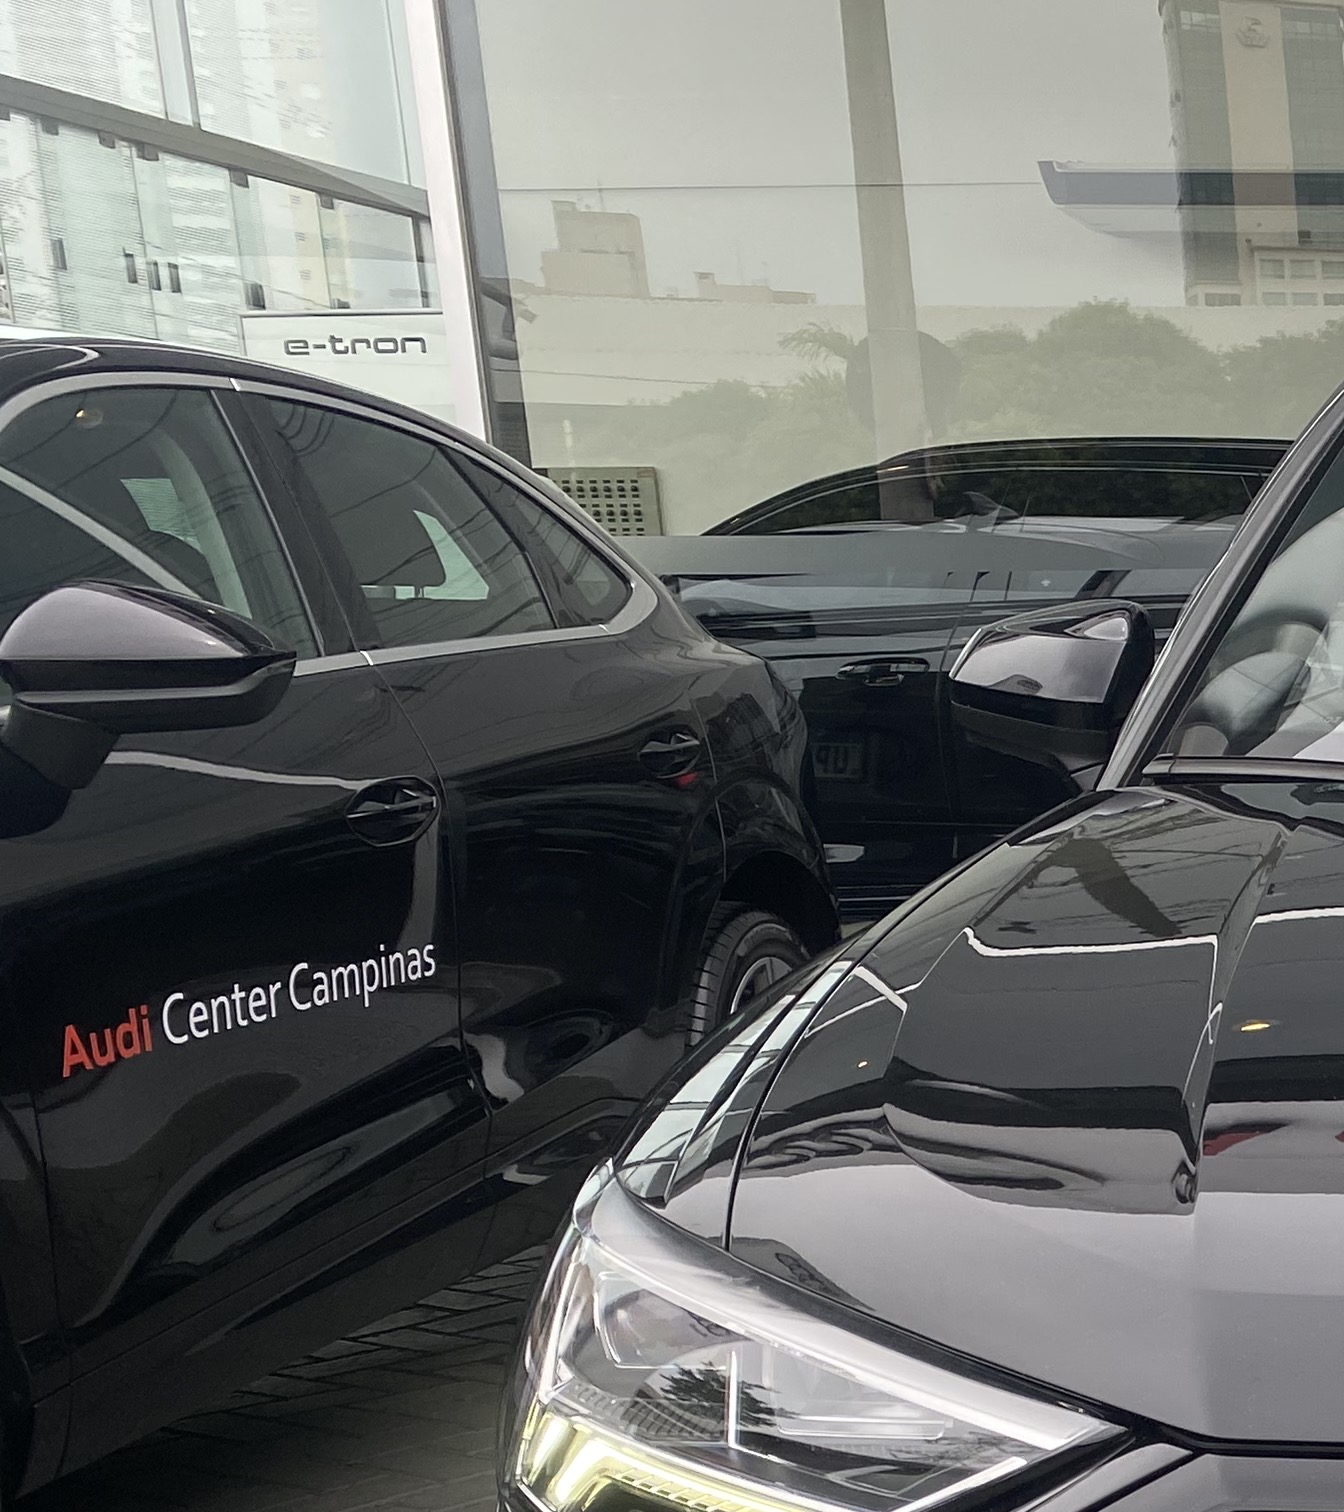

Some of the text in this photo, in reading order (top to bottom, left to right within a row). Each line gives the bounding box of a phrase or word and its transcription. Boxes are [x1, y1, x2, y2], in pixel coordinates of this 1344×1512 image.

[283, 334, 428, 356] e-tron
[62, 943, 437, 1078] Audi Center Campinas
